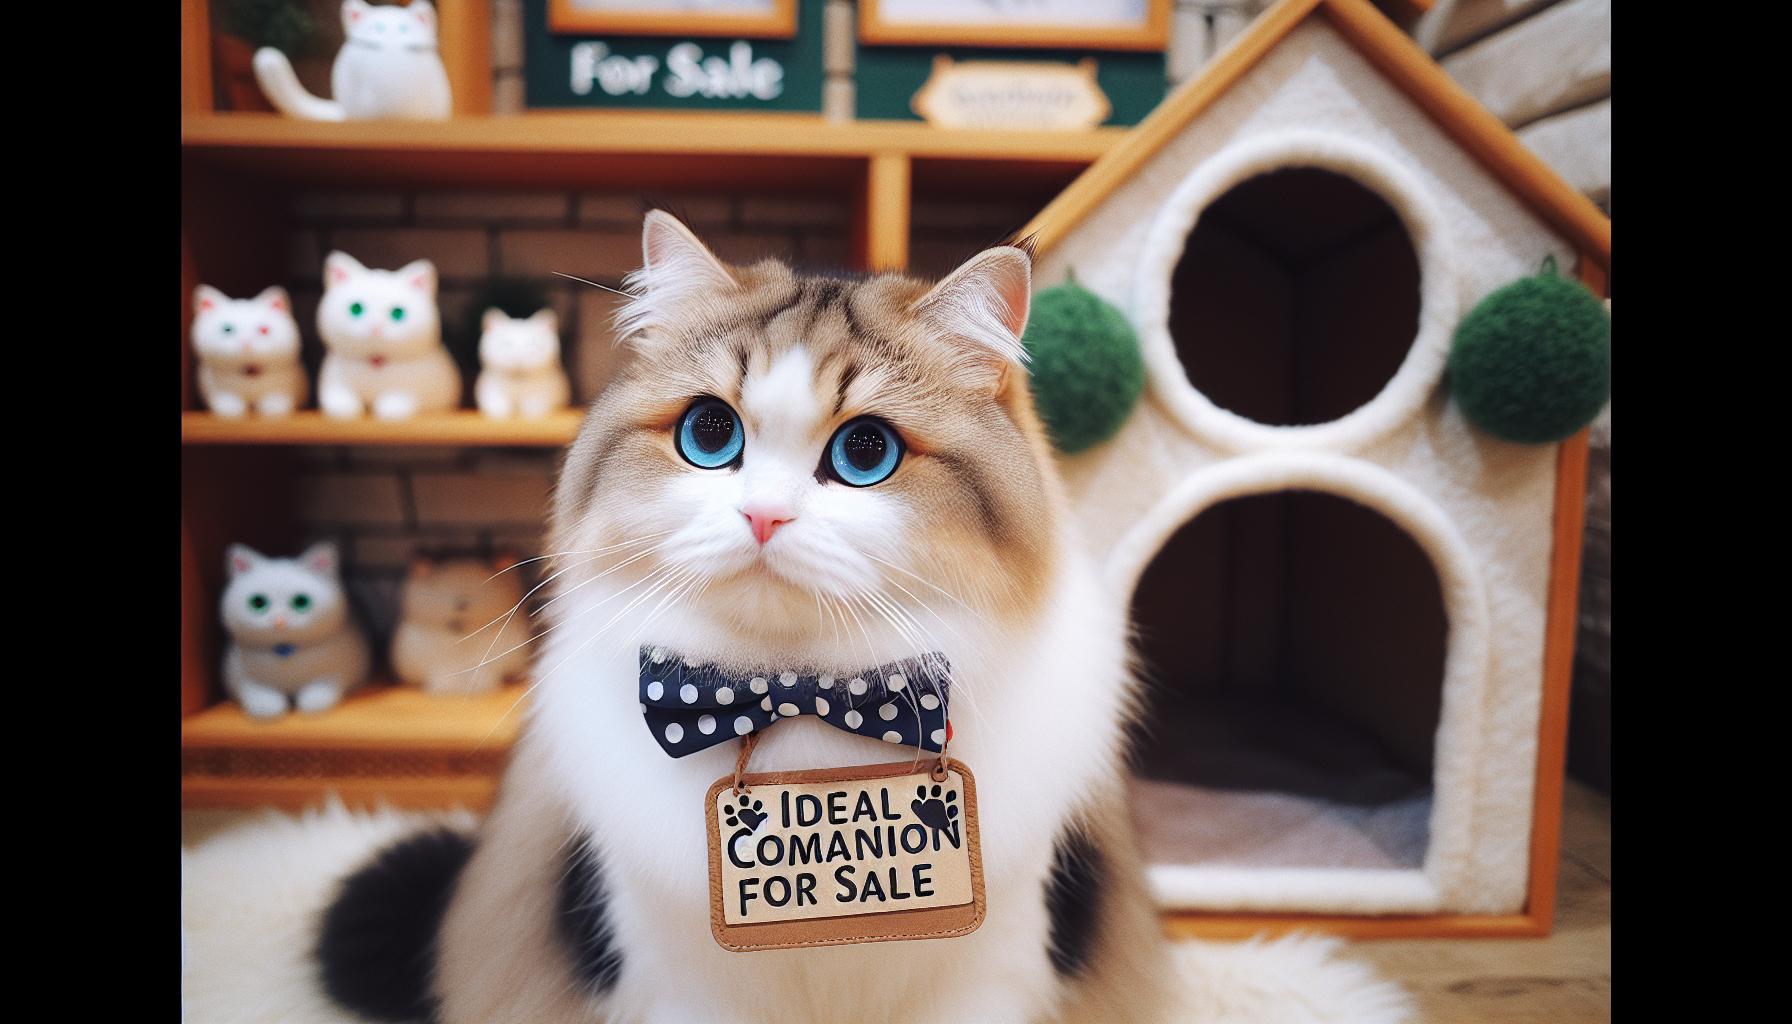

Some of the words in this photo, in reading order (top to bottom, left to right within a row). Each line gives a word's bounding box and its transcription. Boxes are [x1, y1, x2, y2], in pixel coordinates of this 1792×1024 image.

[570, 40, 659, 96] For
[663, 40, 784, 100] Sale
[781, 787, 901, 828] IDEAL
[727, 820, 960, 868] COMANION
[739, 872, 817, 916] FOR
[834, 863, 934, 902] SALE
